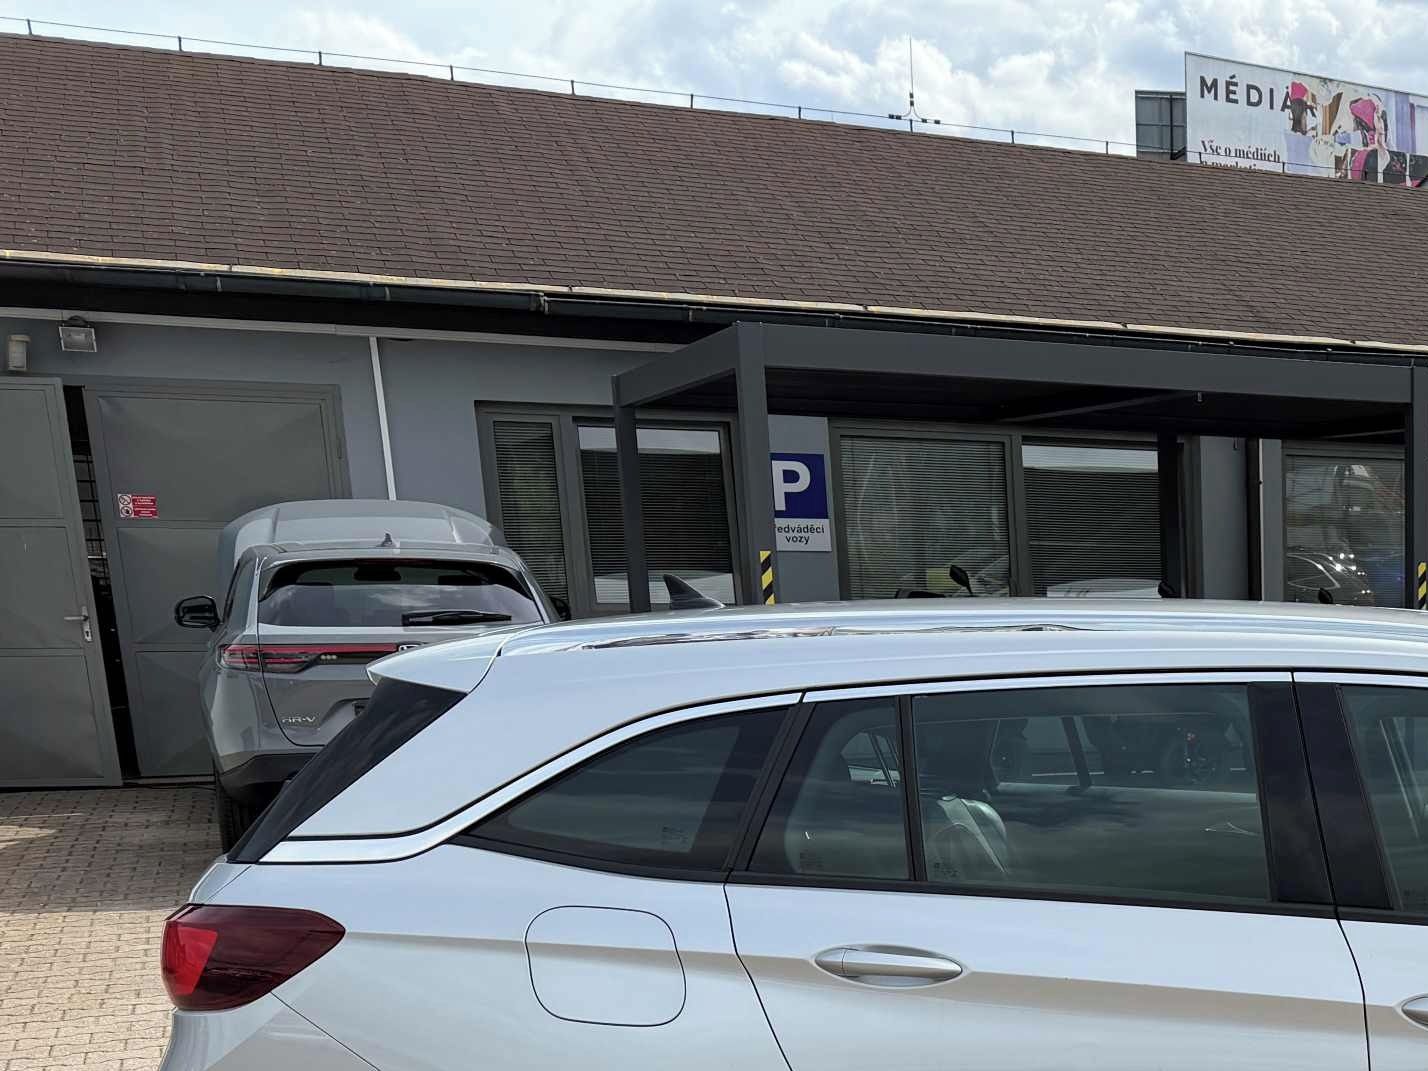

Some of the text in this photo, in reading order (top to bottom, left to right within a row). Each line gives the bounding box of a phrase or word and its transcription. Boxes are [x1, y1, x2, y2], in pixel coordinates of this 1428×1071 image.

[1199, 74, 1317, 118] MÉDIÁ
[771, 459, 811, 511] P
[777, 523, 825, 534] edváděcí
[785, 535, 810, 545] vozy
